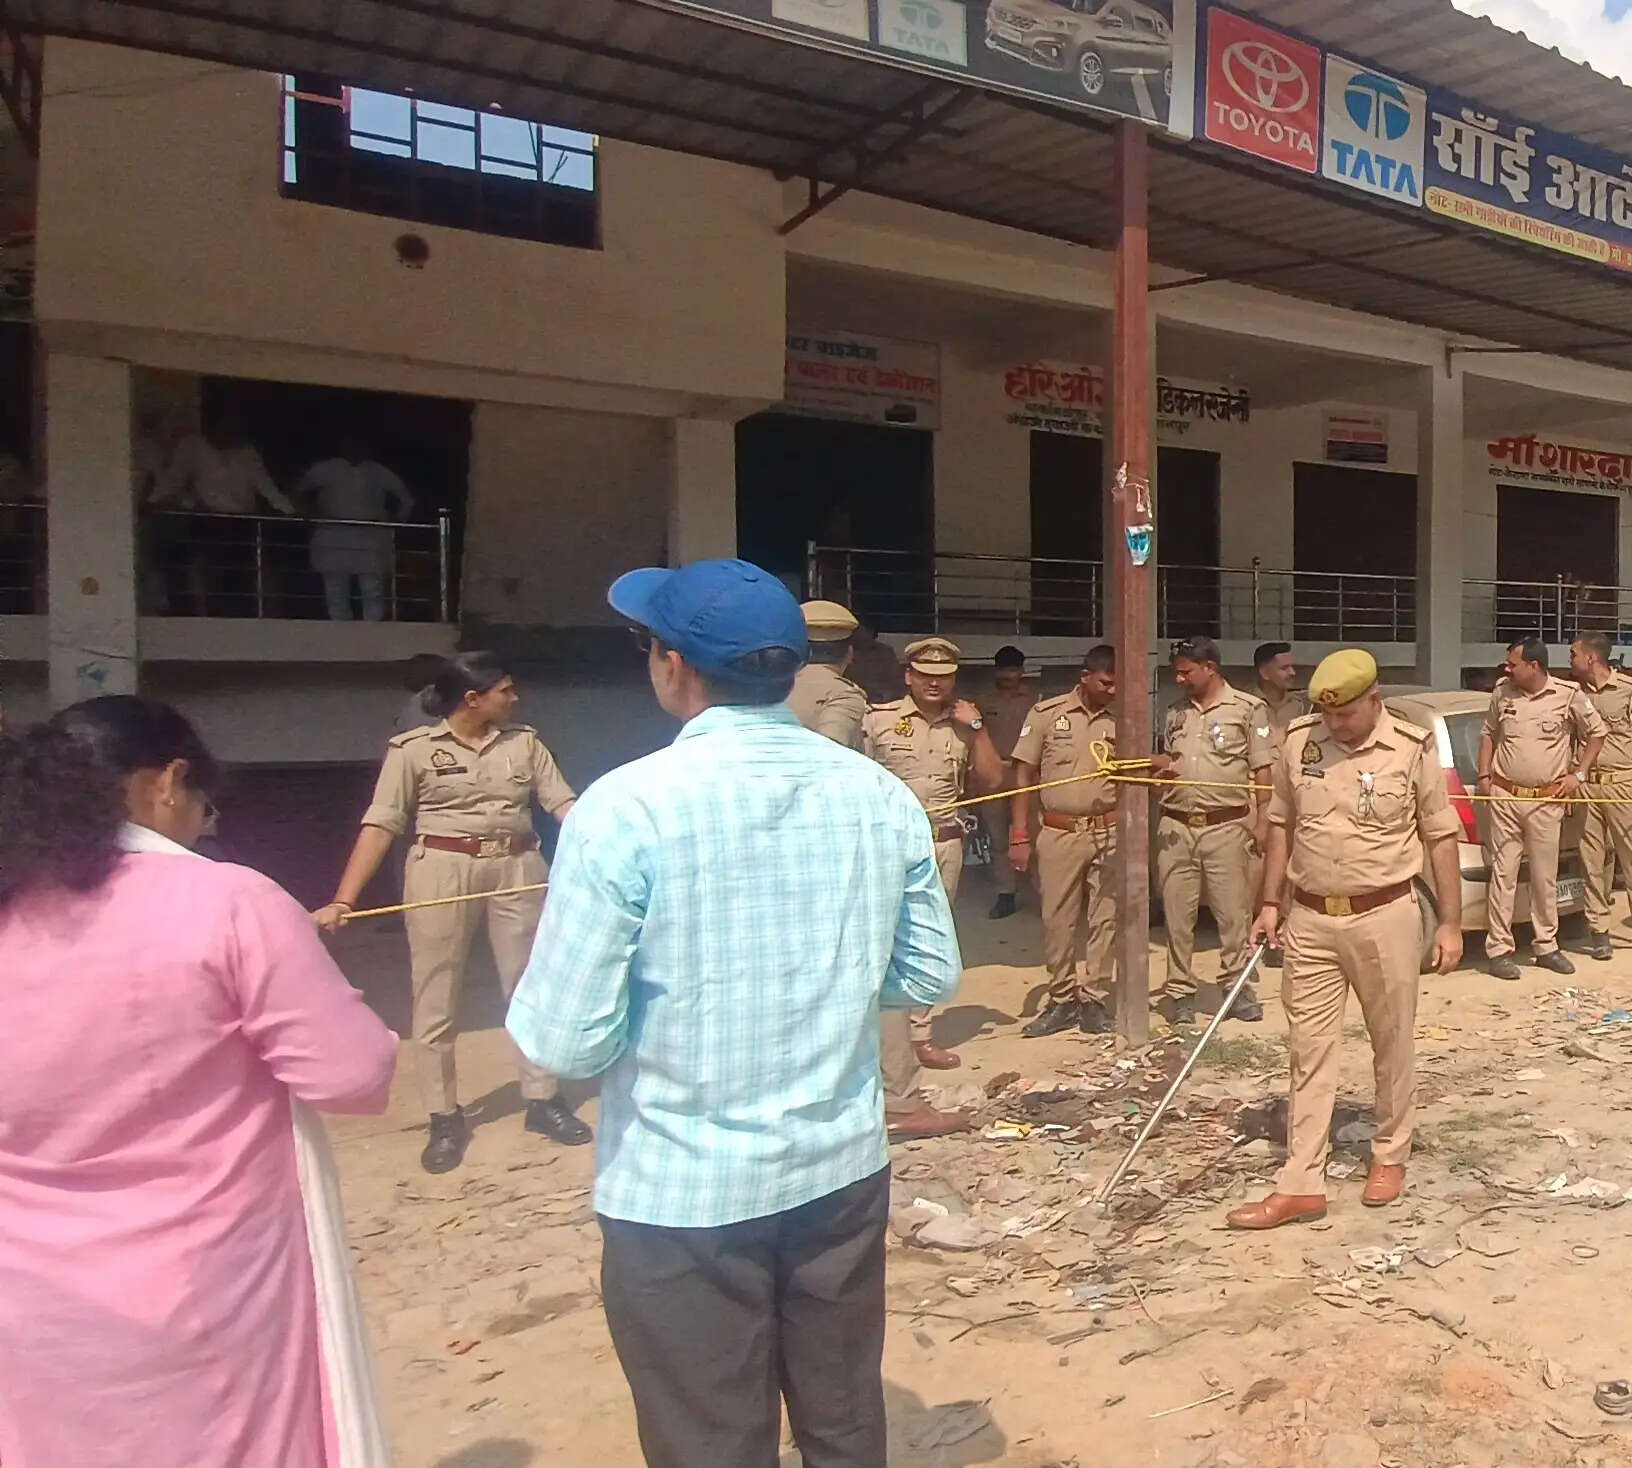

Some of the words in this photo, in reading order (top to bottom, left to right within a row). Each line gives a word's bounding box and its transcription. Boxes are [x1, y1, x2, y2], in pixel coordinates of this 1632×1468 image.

[892, 27, 950, 55] TATA
[1213, 101, 1315, 155] TOYOTA
[1330, 139, 1419, 199] TATA
